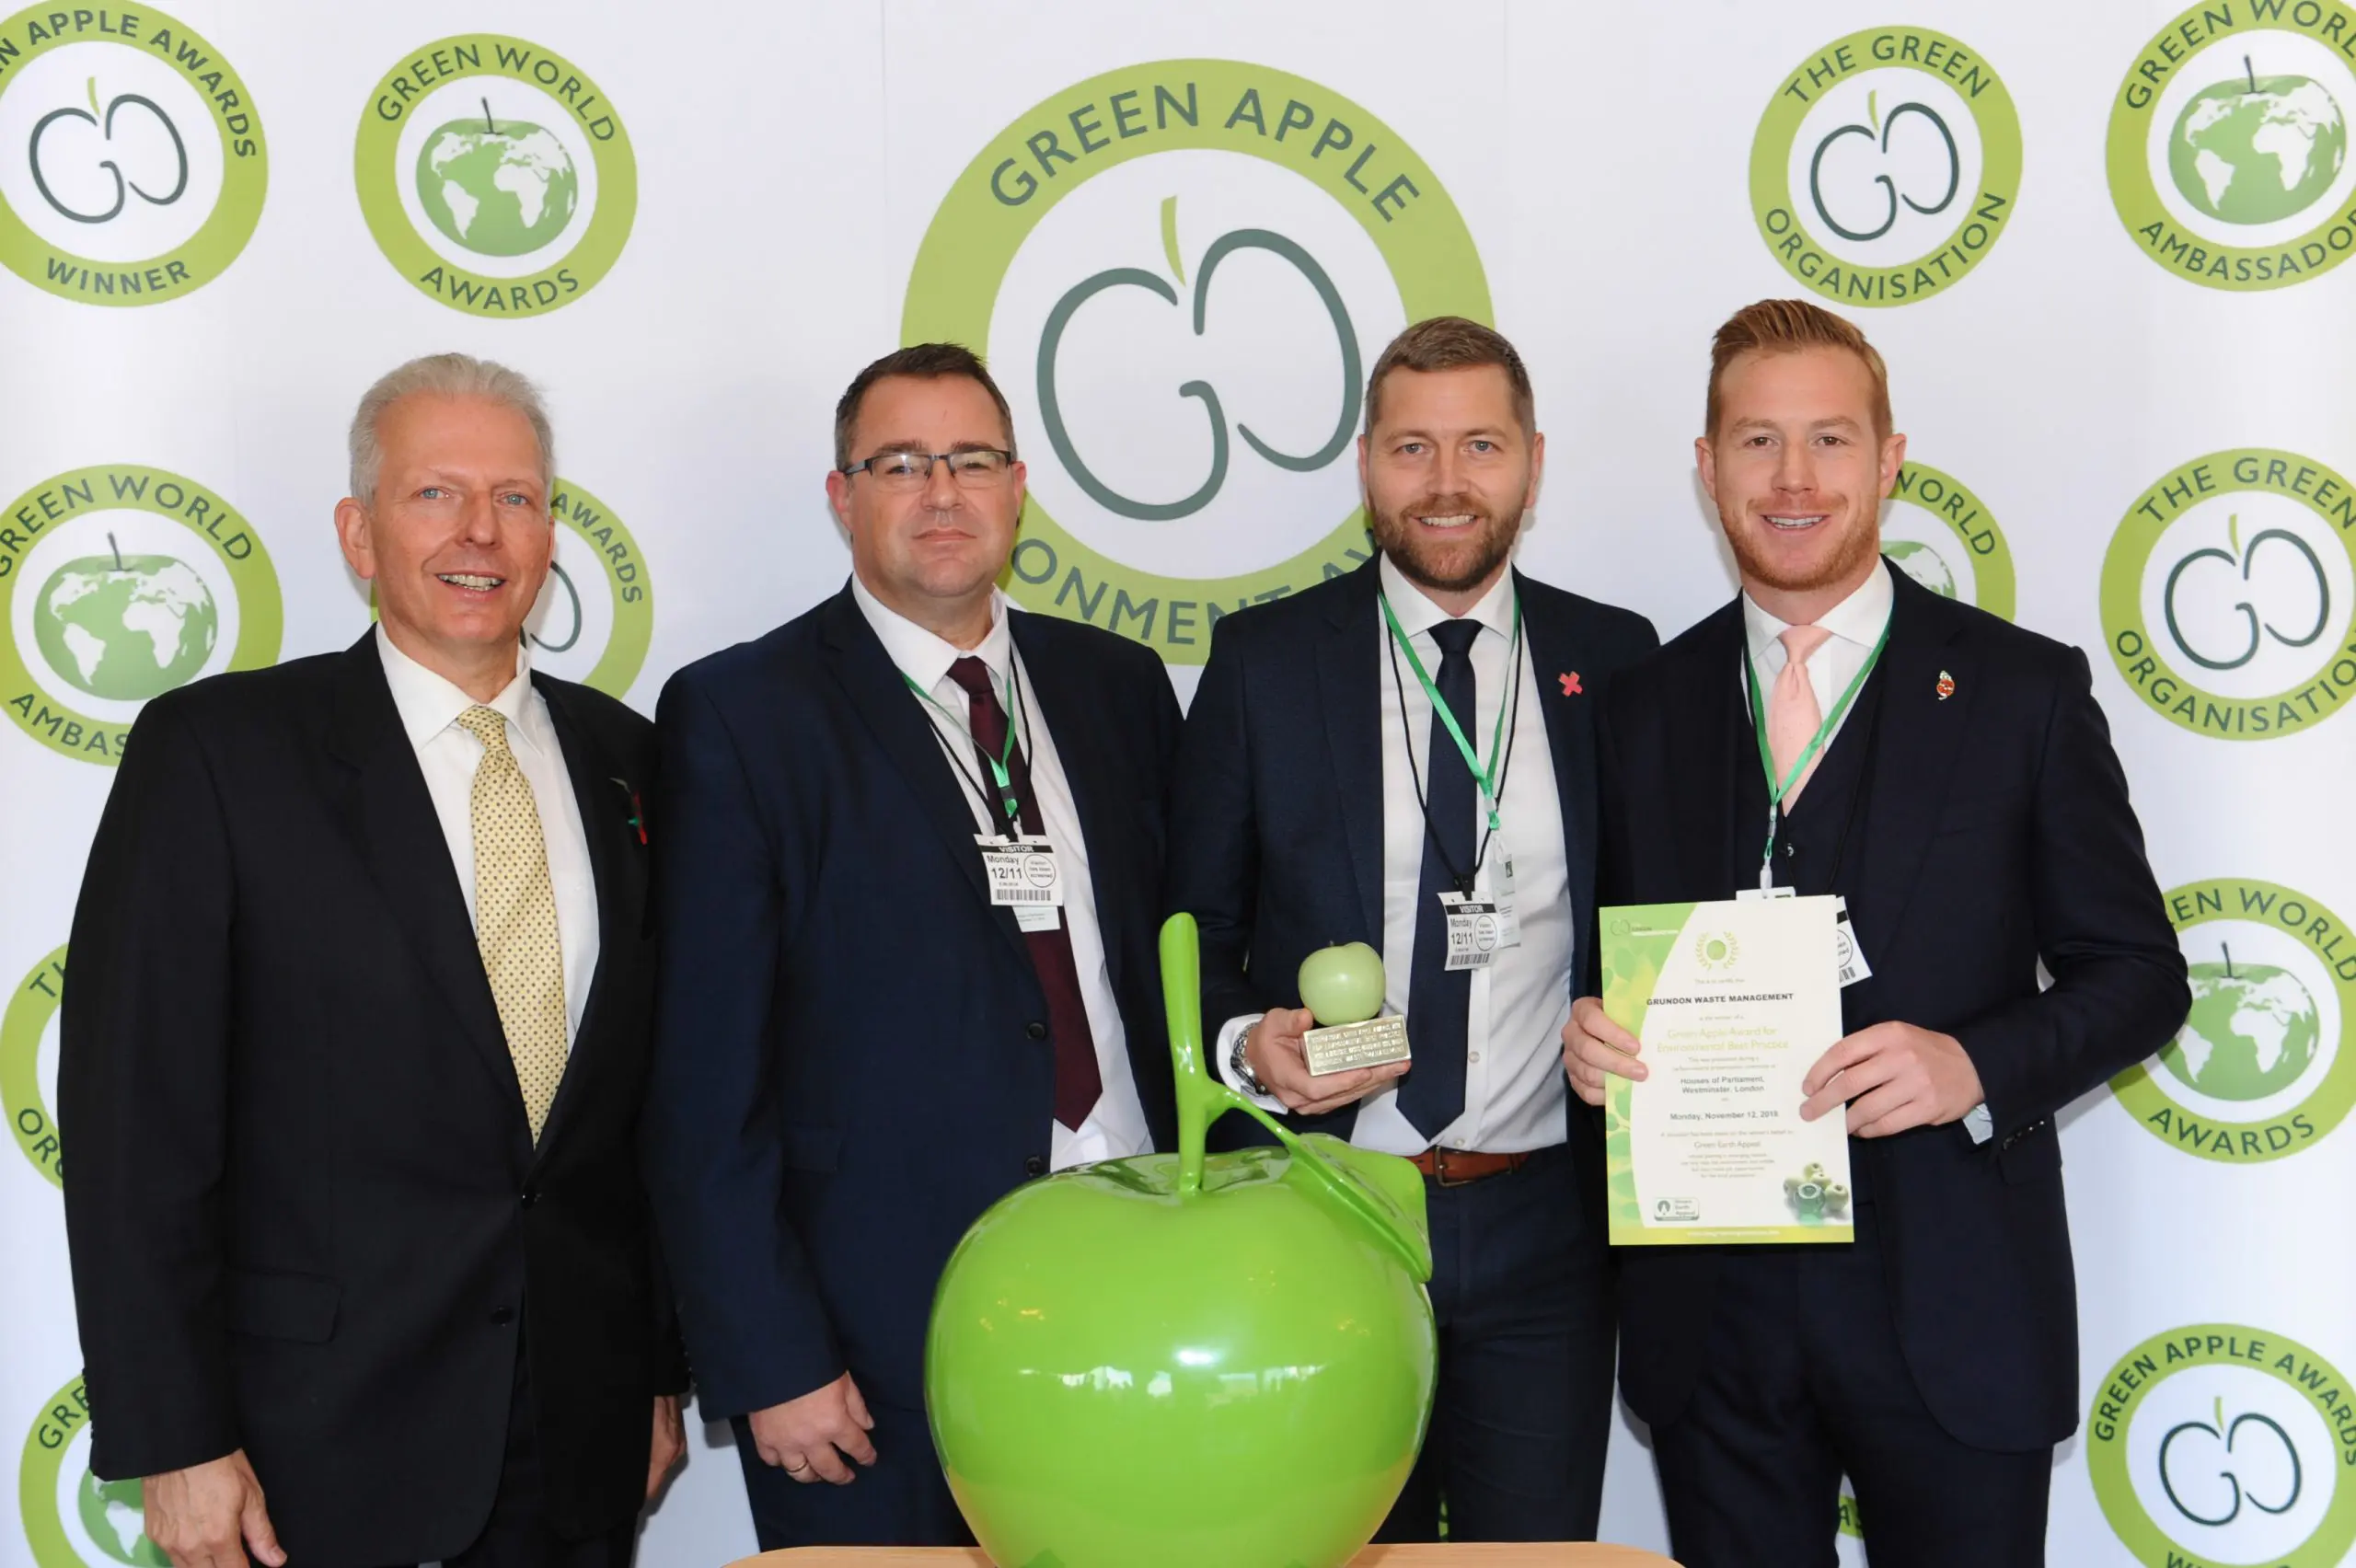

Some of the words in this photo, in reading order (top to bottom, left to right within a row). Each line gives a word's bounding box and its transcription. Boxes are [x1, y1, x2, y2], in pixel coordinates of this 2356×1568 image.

[1784, 45, 1857, 103] THE
[1871, 35, 1992, 98] GREEN
[2126, 4, 2233, 109] GREEN
[28, 9, 139, 45] APPLE
[150, 29, 256, 157] AWARDS
[376, 44, 480, 121] GREEN
[495, 44, 616, 143] WORLD
[990, 82, 1197, 206] GREEN
[1224, 88, 1420, 222] APPLE
[1766, 192, 2006, 300] ORGANISATION
[45, 258, 191, 294] WINNER
[421, 267, 580, 312] AWARDS
[109, 474, 252, 560] WORLD
[2138, 465, 2216, 524] THE
[2234, 457, 2356, 530] GREEN
[550, 493, 642, 603] AWARDS
[2117, 629, 2356, 732] ORGANISATIO
[987, 855, 1019, 865] Monday
[991, 867, 1022, 879] 12/11
[1450, 918, 1472, 928] Monday
[1459, 905, 1484, 913] VISITOR
[1450, 932, 1472, 944] 12/11
[2238, 887, 2356, 982] WORLD
[1646, 997, 1692, 1005] GRUNDON
[1695, 996, 1727, 1004] WASTE
[1729, 993, 1794, 1002] MANAGEMENT
[1668, 1029, 1697, 1038] Green
[1700, 1027, 1727, 1039] Apple
[1730, 1026, 1761, 1036] Award
[1762, 1025, 1777, 1035] for
[1727, 1041, 1749, 1050] Best
[1680, 1077, 1709, 1085] Houses
[1721, 1076, 1764, 1084] Parliament,
[1670, 1113, 1703, 1121] Monday,
[1705, 1112, 1745, 1120] November
[2148, 1108, 2314, 1156] AWARDS
[2095, 1355, 2158, 1442] GREEN
[2165, 1335, 2266, 1363] APPLE
